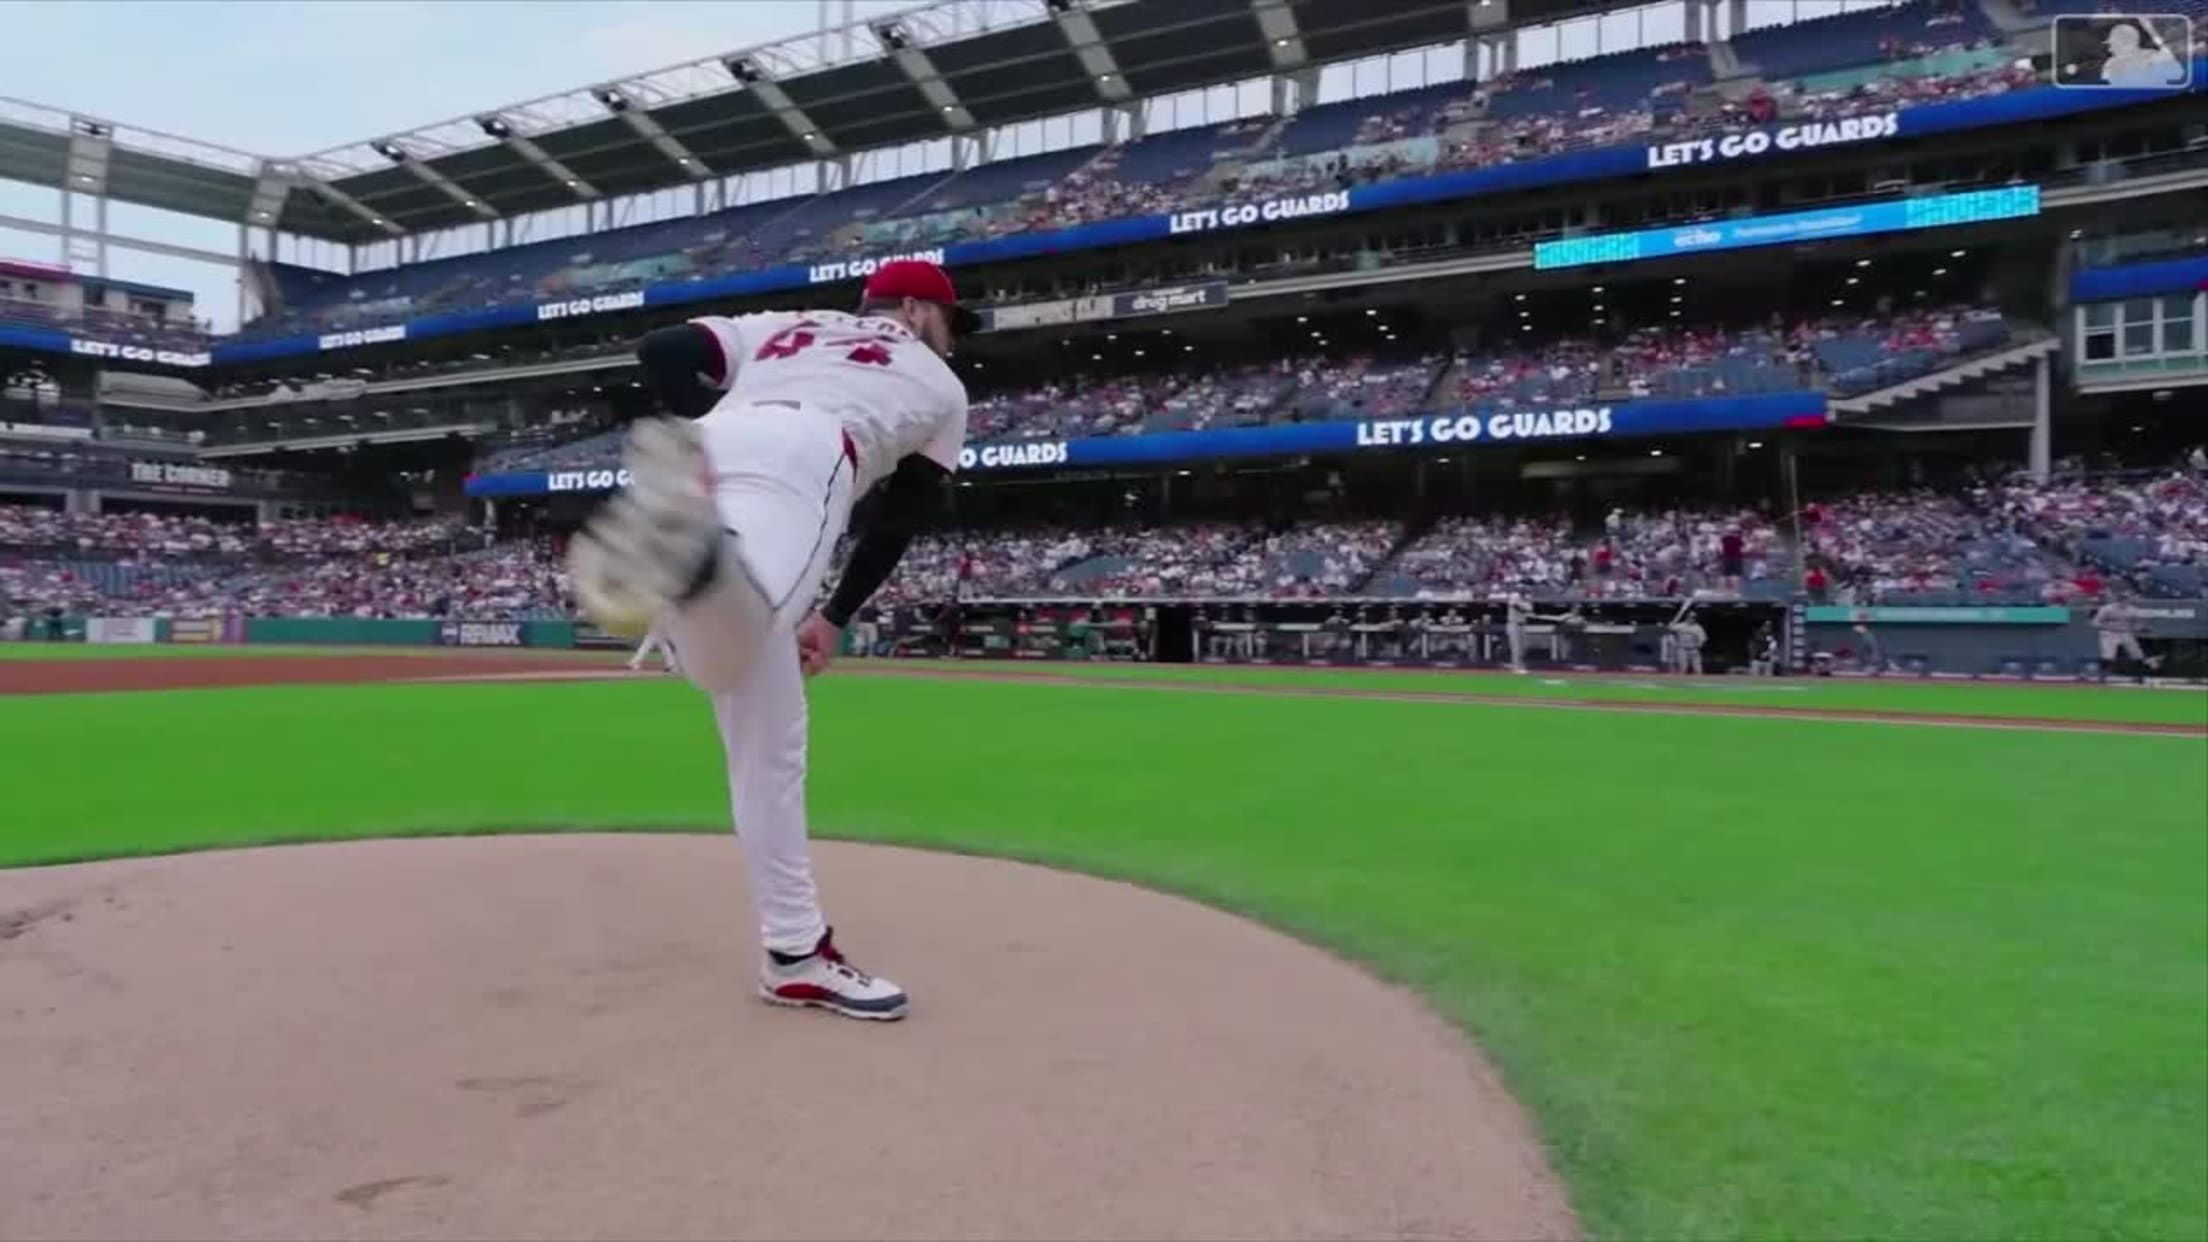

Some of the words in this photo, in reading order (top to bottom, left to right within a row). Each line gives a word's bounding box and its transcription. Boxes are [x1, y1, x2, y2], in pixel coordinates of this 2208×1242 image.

[1648, 139, 1713, 167] LET'S
[1719, 132, 1770, 157] GO
[1775, 113, 1898, 149] GUARDS
[1170, 210, 1219, 233] LET'S
[1222, 205, 1259, 225] GO
[1262, 190, 1350, 220] GUARDS
[810, 263, 846, 282] LET'S
[849, 259, 877, 276] GO
[538, 302, 568, 320] LET'S
[569, 299, 591, 315] GO
[1132, 297, 1166, 312] drug
[121, 346, 154, 360] GO
[1357, 419, 1424, 446] LET'S
[1430, 415, 1481, 442] GO
[1487, 407, 1612, 438] GUARDS
[959, 447, 977, 469] O
[980, 441, 1068, 467] GUARDS
[548, 472, 585, 491] LET'S
[586, 469, 614, 488] GO
